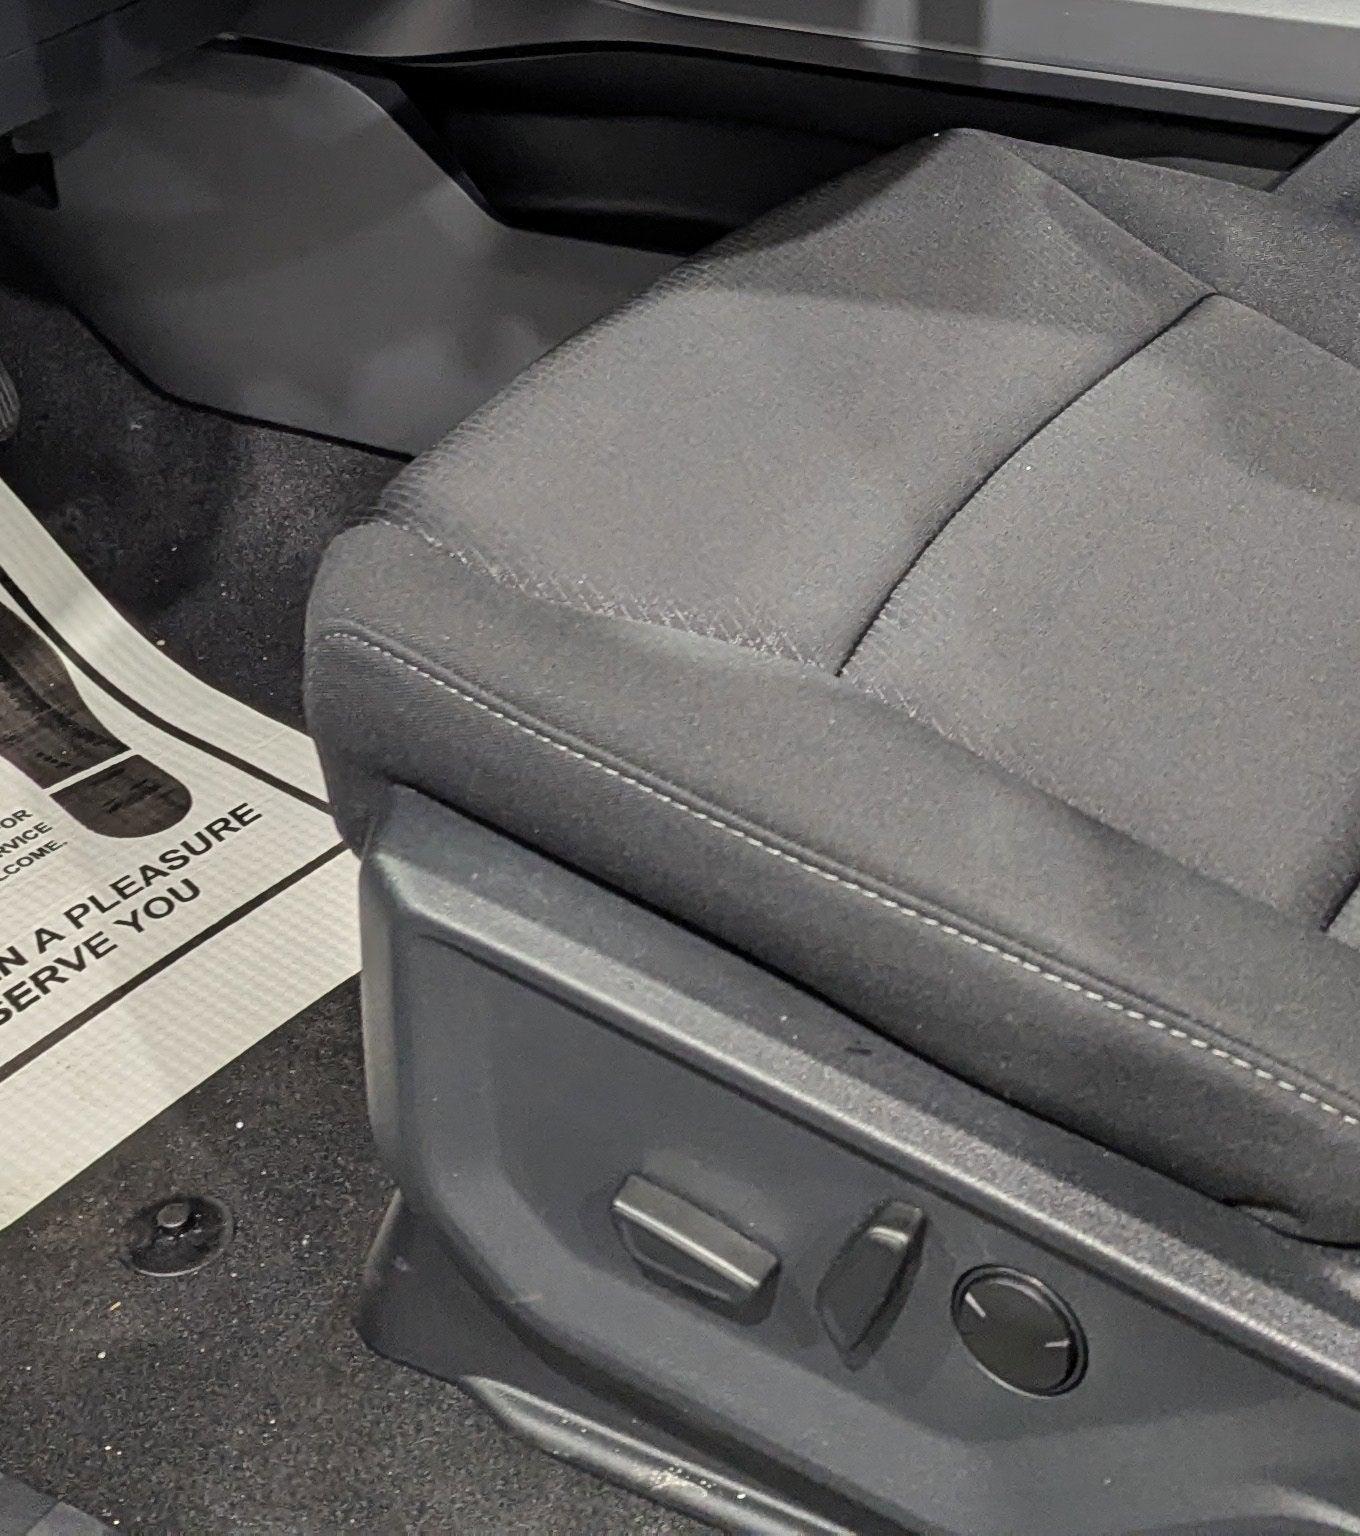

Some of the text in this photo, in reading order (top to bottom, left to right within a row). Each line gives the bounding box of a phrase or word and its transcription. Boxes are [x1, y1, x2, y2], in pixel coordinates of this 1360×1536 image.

[33, 926, 65, 956] A
[64, 801, 264, 931] PLEASURE
[113, 877, 202, 935] YOU
